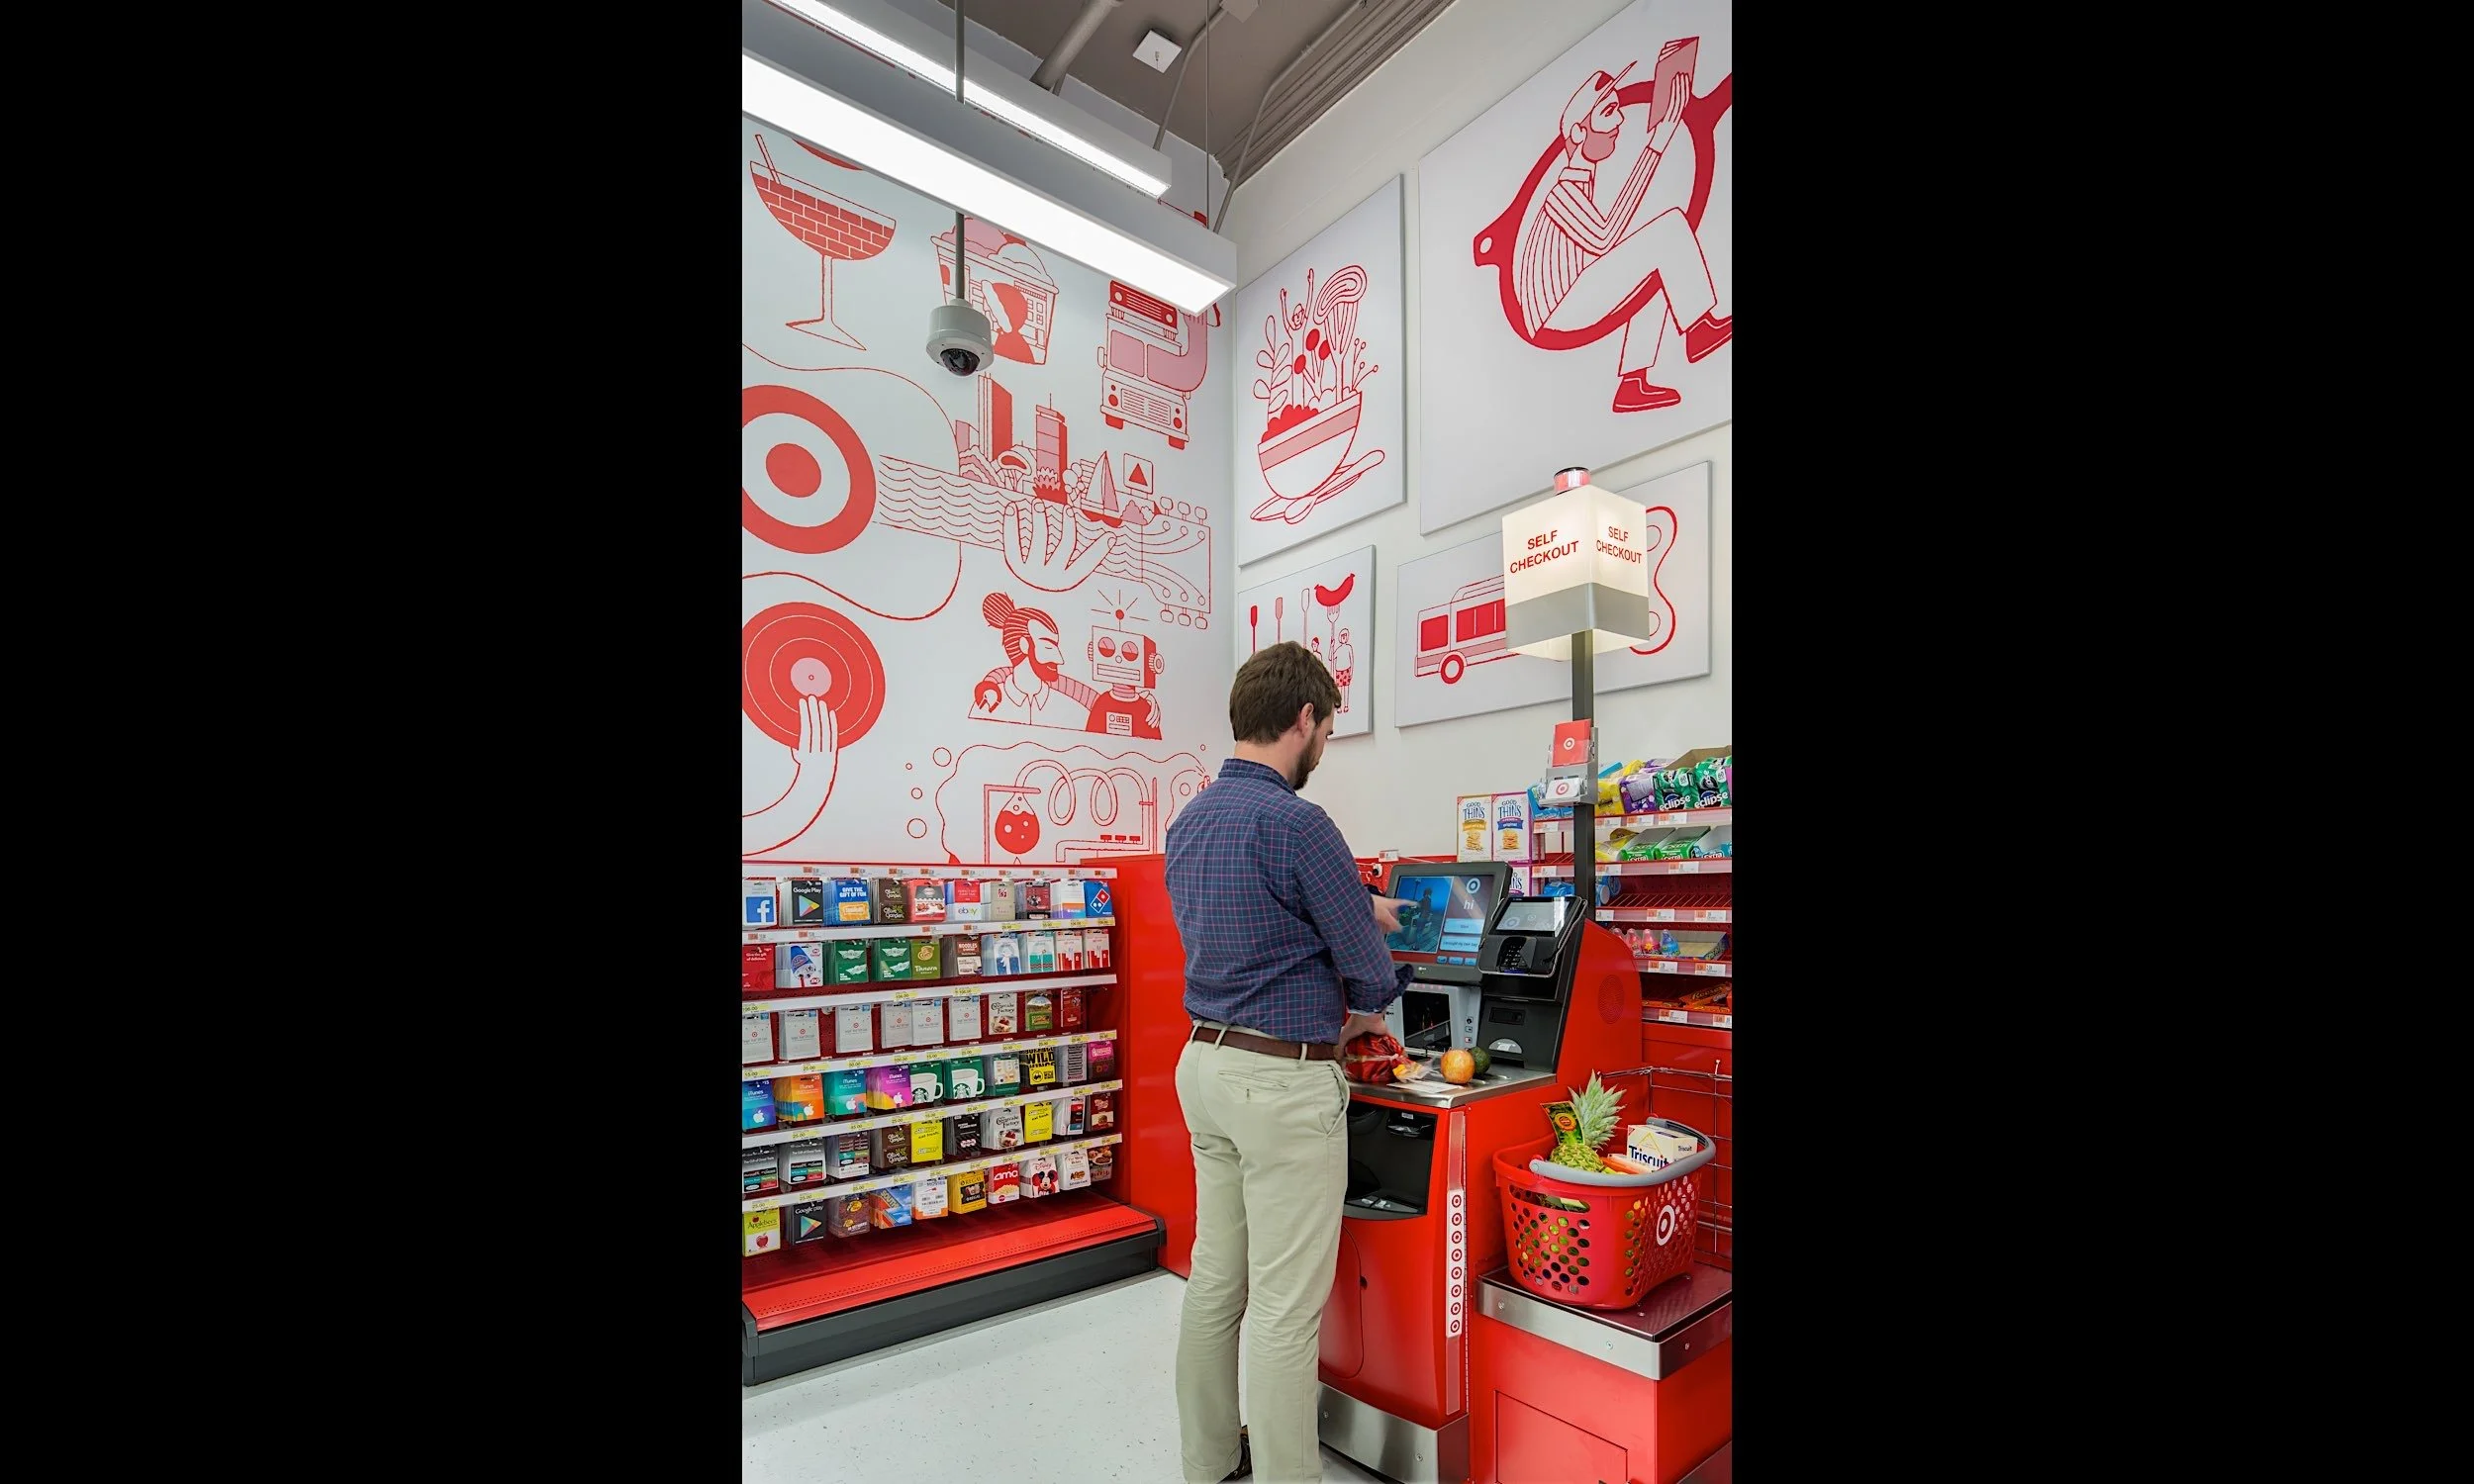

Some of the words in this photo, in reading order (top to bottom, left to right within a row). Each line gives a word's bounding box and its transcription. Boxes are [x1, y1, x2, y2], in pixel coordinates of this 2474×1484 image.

[1527, 530, 1558, 550] SELF
[1608, 526, 1629, 542] SELF
[1510, 541, 1578, 573] CHECKOUT
[1596, 540, 1642, 564] CHECKOUT
[1660, 794, 1690, 811] eclipse
[1694, 791, 1728, 809] eclipse
[1464, 900, 1475, 909] hi
[1026, 1051, 1054, 1065] WILD
[1628, 1145, 1669, 1168] Triscuit
[994, 1169, 1018, 1181] amc
[795, 1206, 813, 1215] Google
